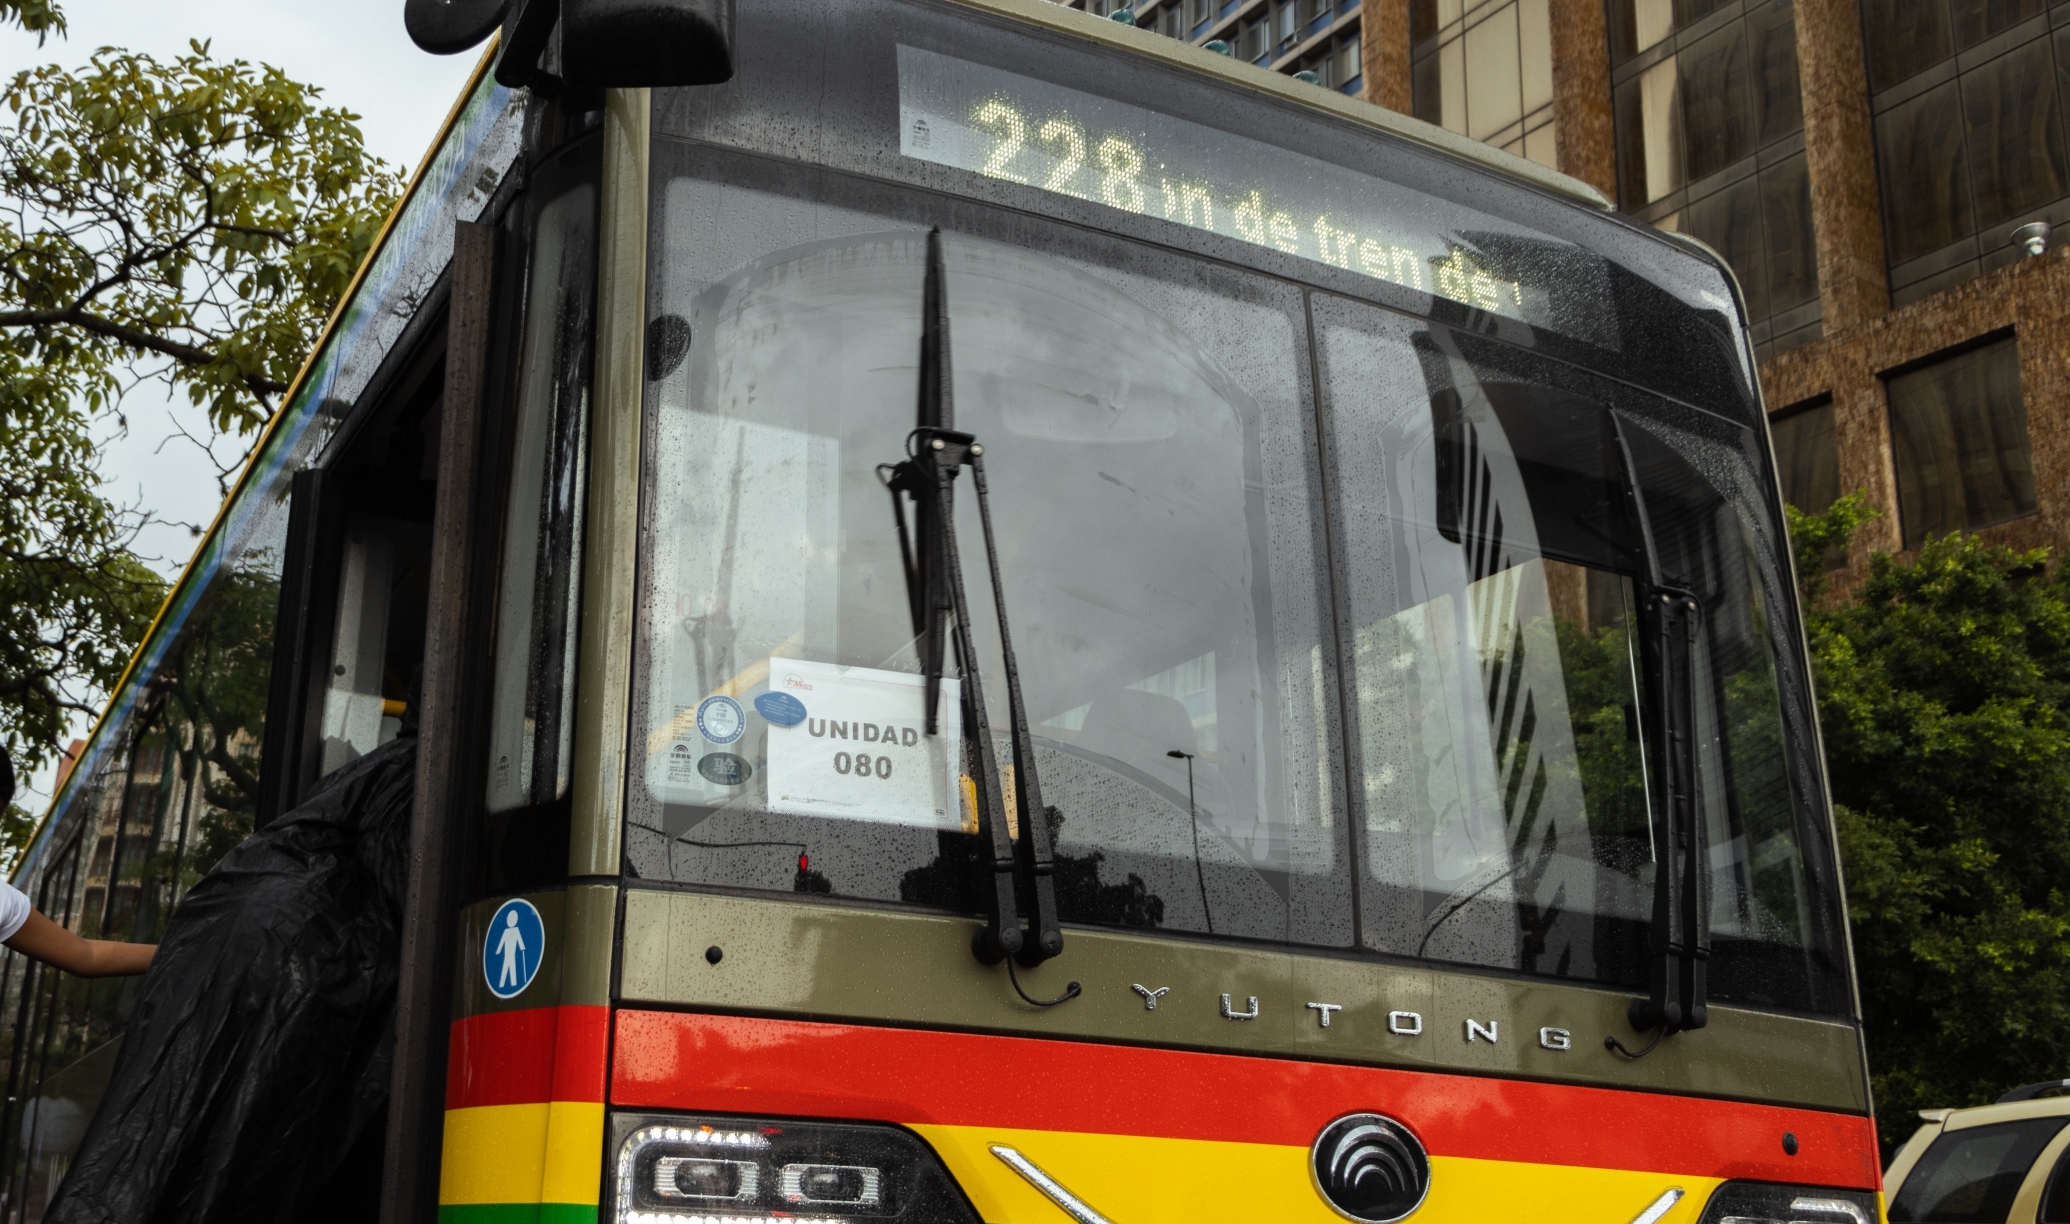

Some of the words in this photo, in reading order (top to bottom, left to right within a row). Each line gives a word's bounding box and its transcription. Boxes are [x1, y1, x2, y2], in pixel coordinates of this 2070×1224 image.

[379, 120, 465, 296] ENTRADA
[979, 102, 1145, 214] 228
[1234, 189, 1298, 254] de
[1313, 215, 1422, 290] tren
[1438, 245, 1499, 311] de
[808, 717, 919, 747] UNIDAD
[833, 751, 893, 780] 080
[1131, 983, 1571, 1051] YUTONG
